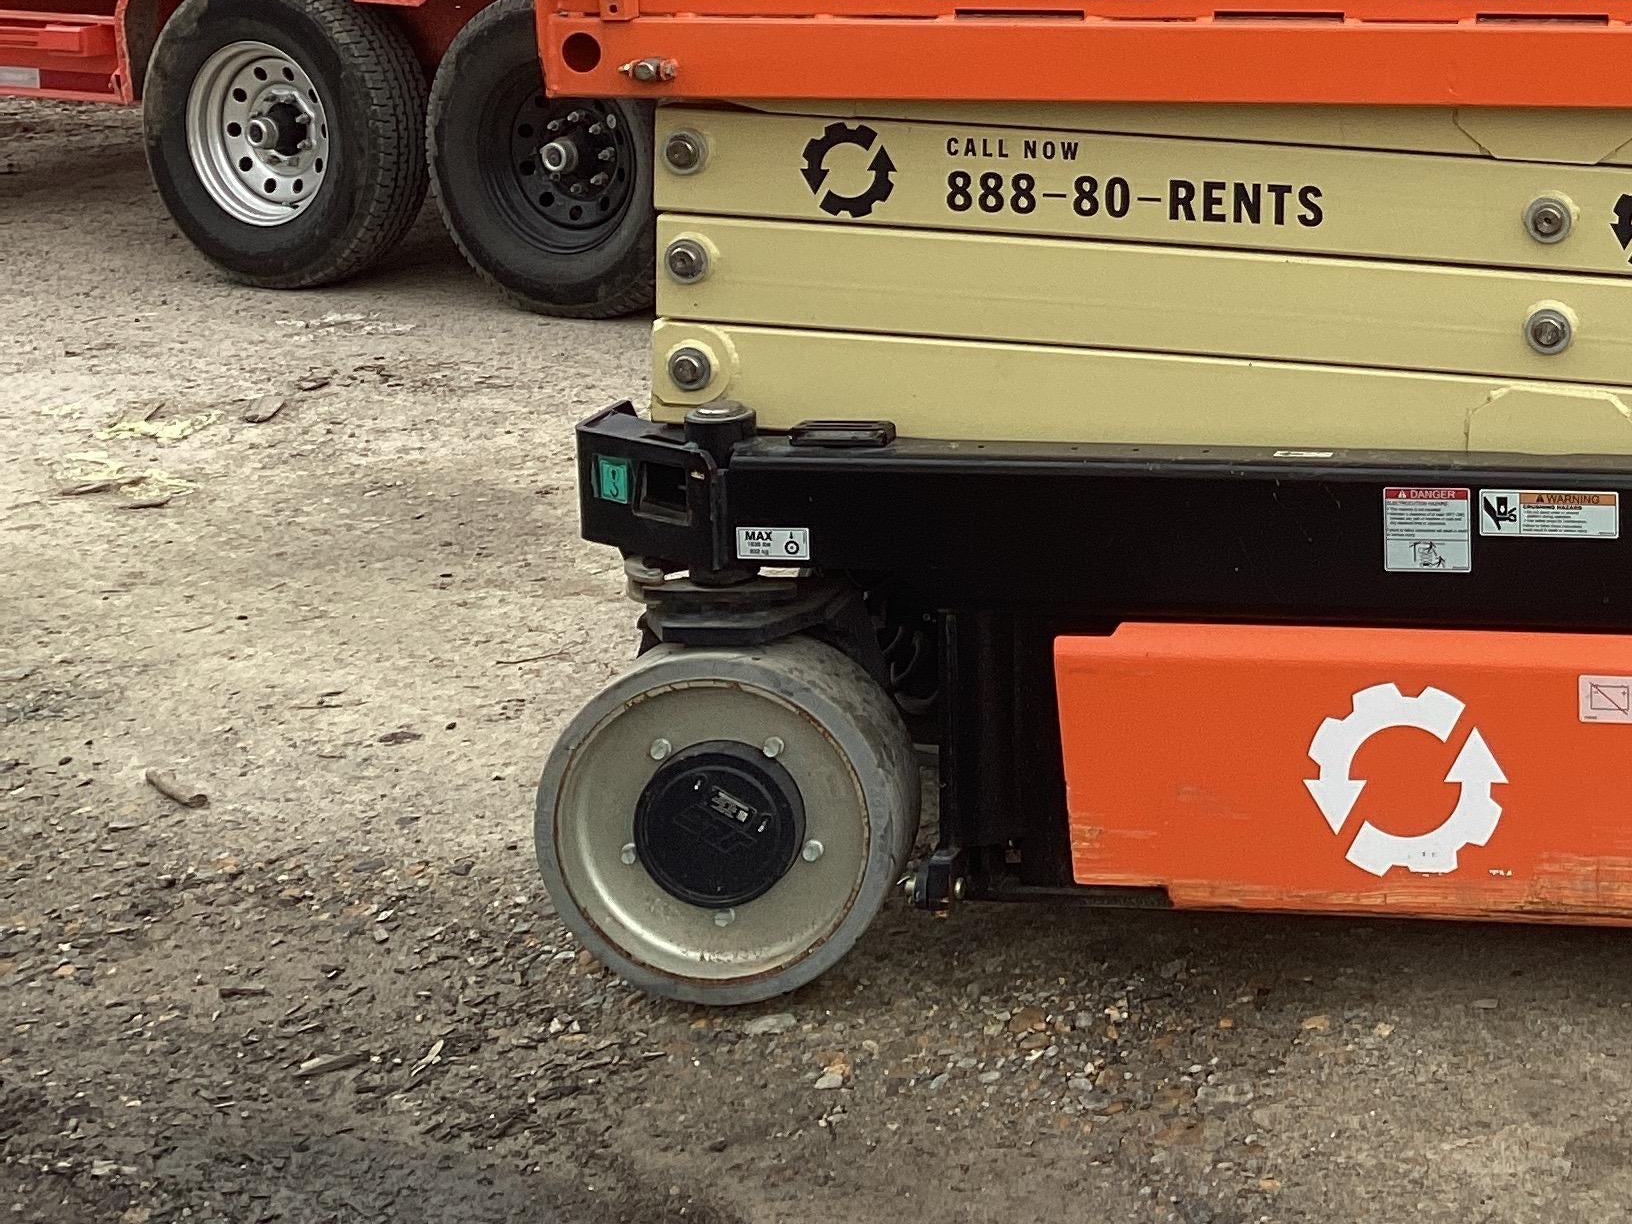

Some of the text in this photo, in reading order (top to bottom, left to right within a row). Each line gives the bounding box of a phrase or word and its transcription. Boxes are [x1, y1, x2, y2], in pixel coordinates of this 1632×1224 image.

[946, 137, 1080, 161] CALL NOW
[945, 170, 1324, 228] 888-80-RENTS
[1410, 489, 1456, 499] DANGER
[1546, 494, 1600, 505] WARNING
[745, 531, 773, 542] MAX
